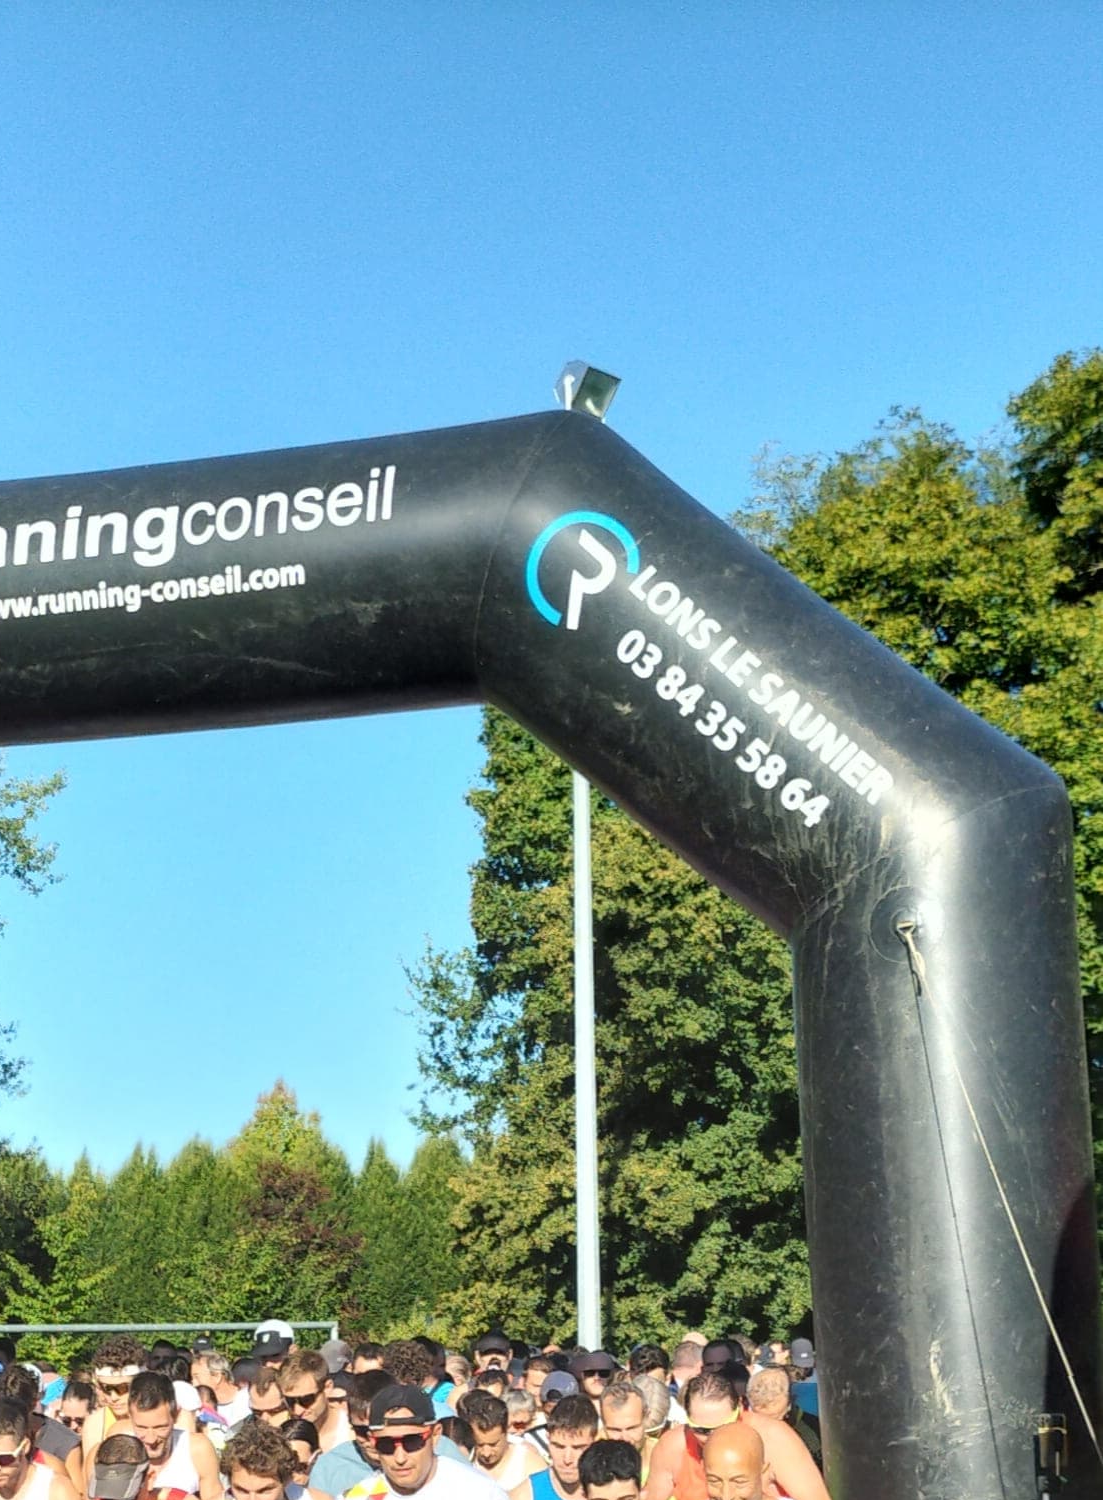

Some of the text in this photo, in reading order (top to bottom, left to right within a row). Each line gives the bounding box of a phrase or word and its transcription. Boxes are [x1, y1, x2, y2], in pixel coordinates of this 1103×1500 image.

[616, 629, 831, 828] 03 84 35 58 64
[628, 565, 895, 805] LONS LE SAUNIER
